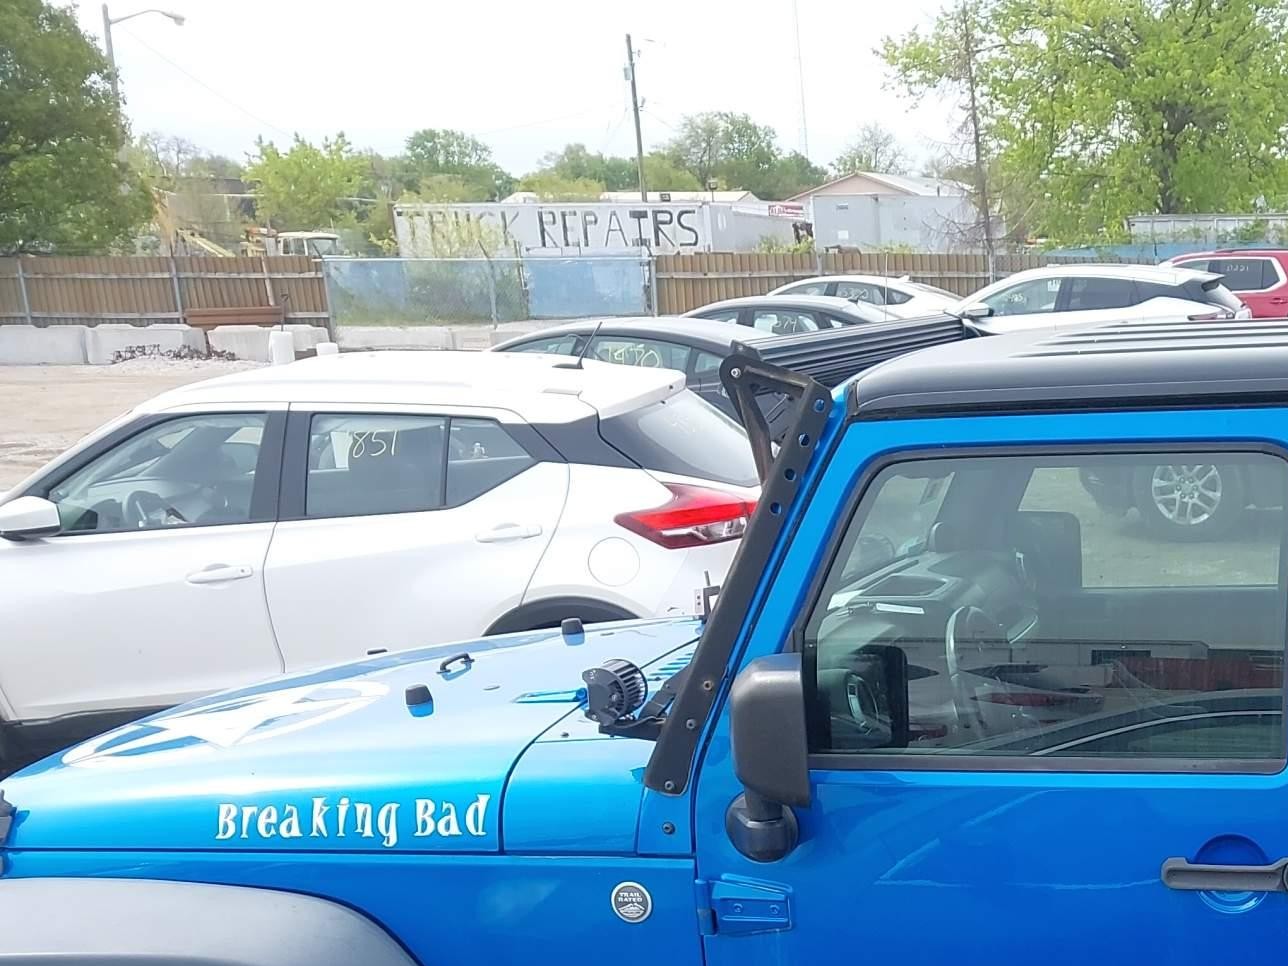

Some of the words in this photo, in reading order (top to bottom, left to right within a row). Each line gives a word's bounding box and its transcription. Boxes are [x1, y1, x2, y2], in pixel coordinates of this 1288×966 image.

[538, 209, 699, 248] REPAIRS
[215, 796, 400, 847] Breaking
[414, 794, 492, 837] Bad
